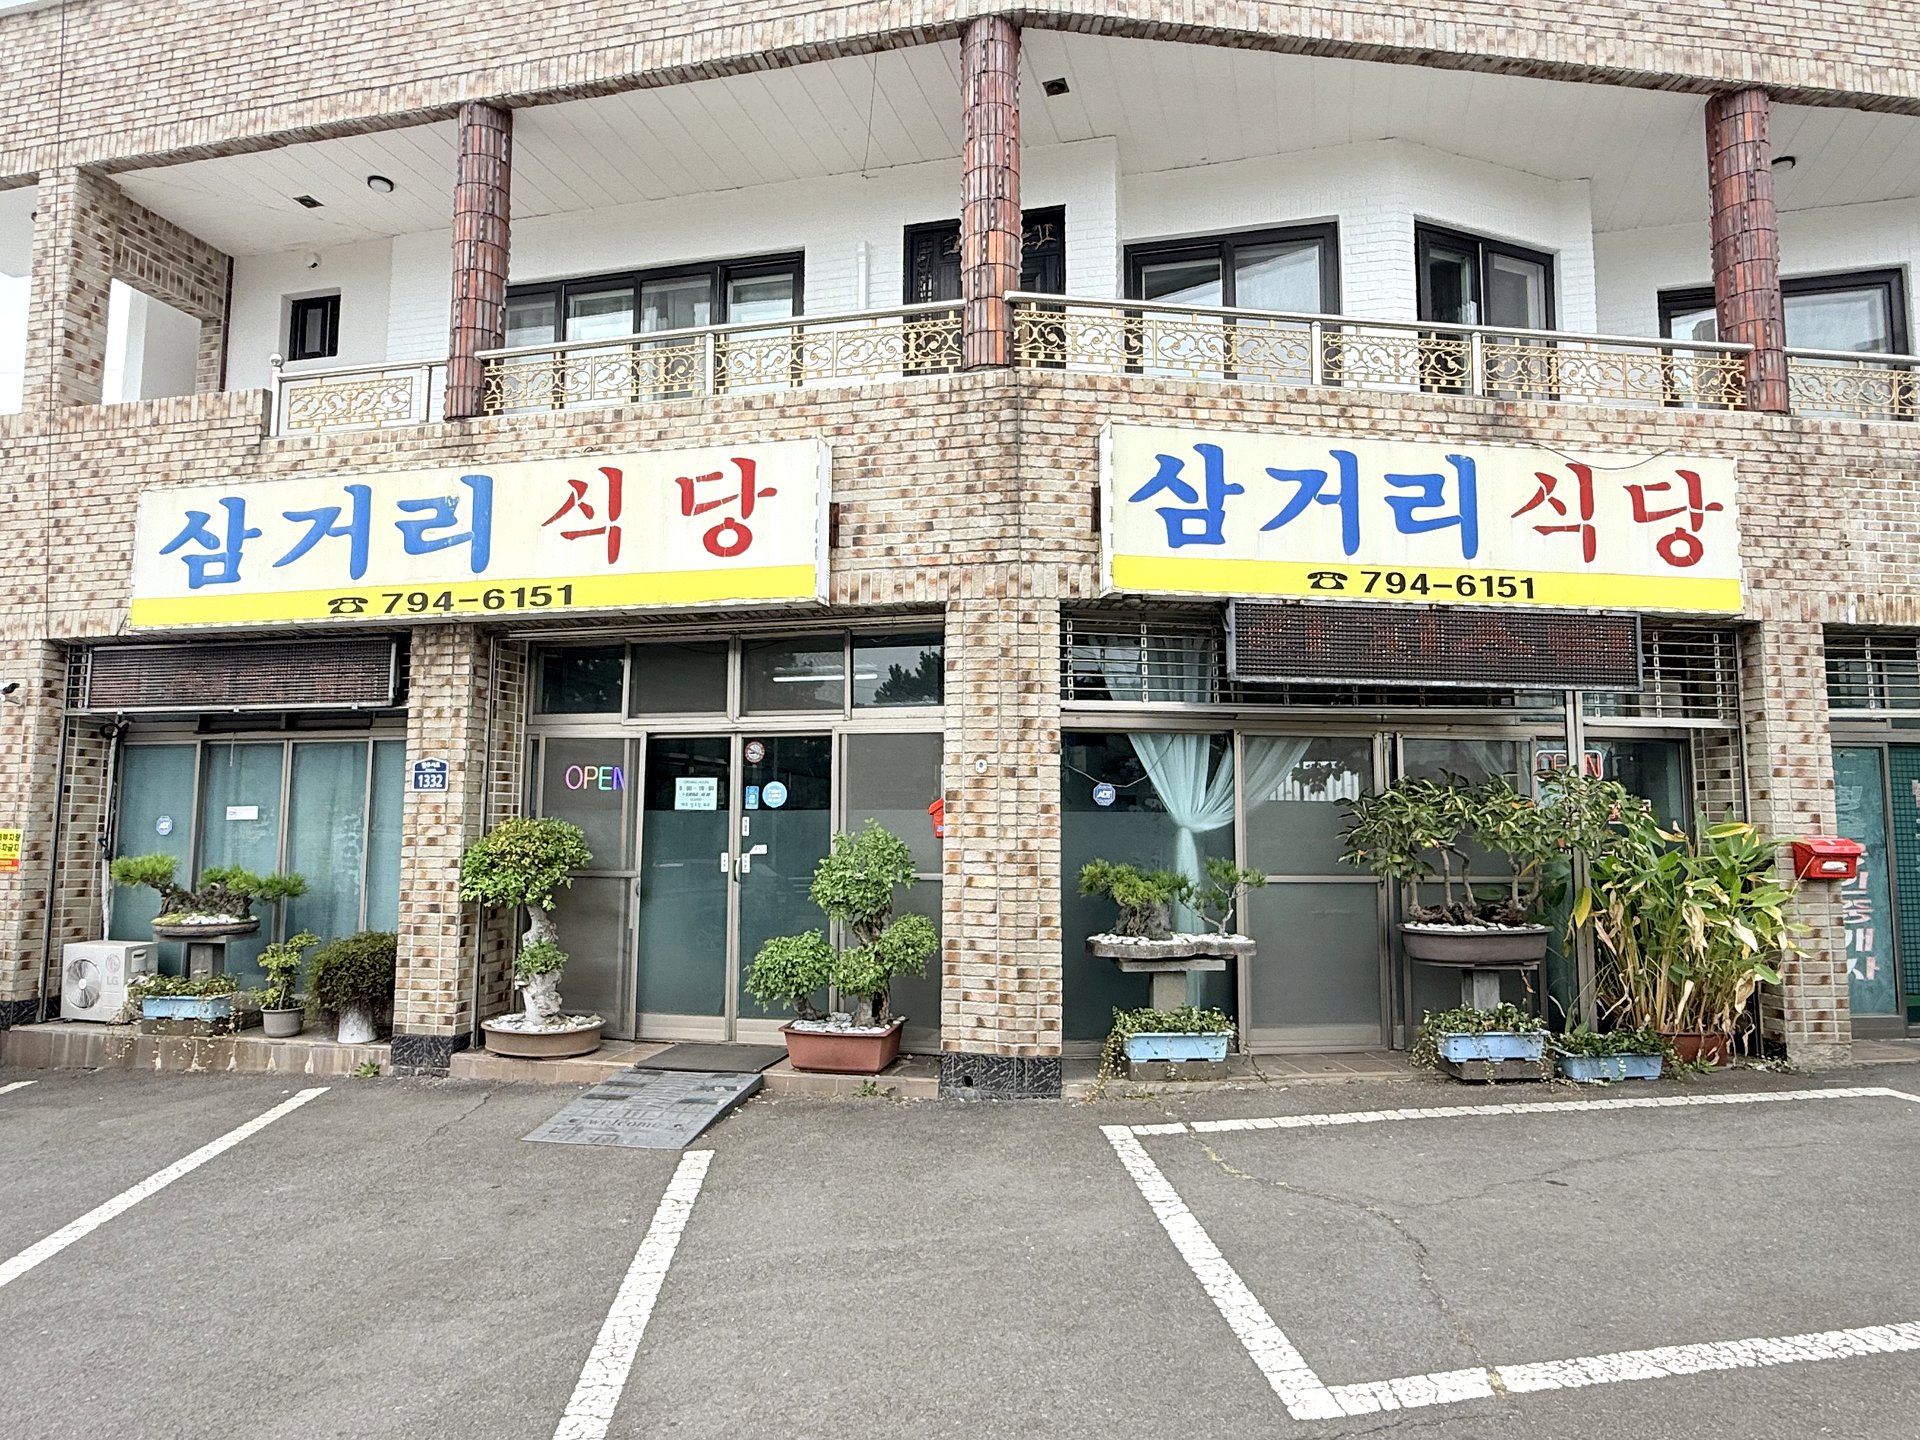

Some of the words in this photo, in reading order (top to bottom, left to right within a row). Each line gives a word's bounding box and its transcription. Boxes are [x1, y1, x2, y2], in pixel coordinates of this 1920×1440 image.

[1128, 443, 1479, 560] 삼거리
[1511, 463, 1723, 567] 식당
[159, 475, 493, 589] 삼거리
[541, 457, 777, 565] 식당
[381, 584, 573, 614] 794-6151
[1360, 571, 1535, 599] 794-6151
[418, 774, 443, 788] 1332
[0, 843, 19, 852] 차금지
[106, 975, 119, 985] LG
